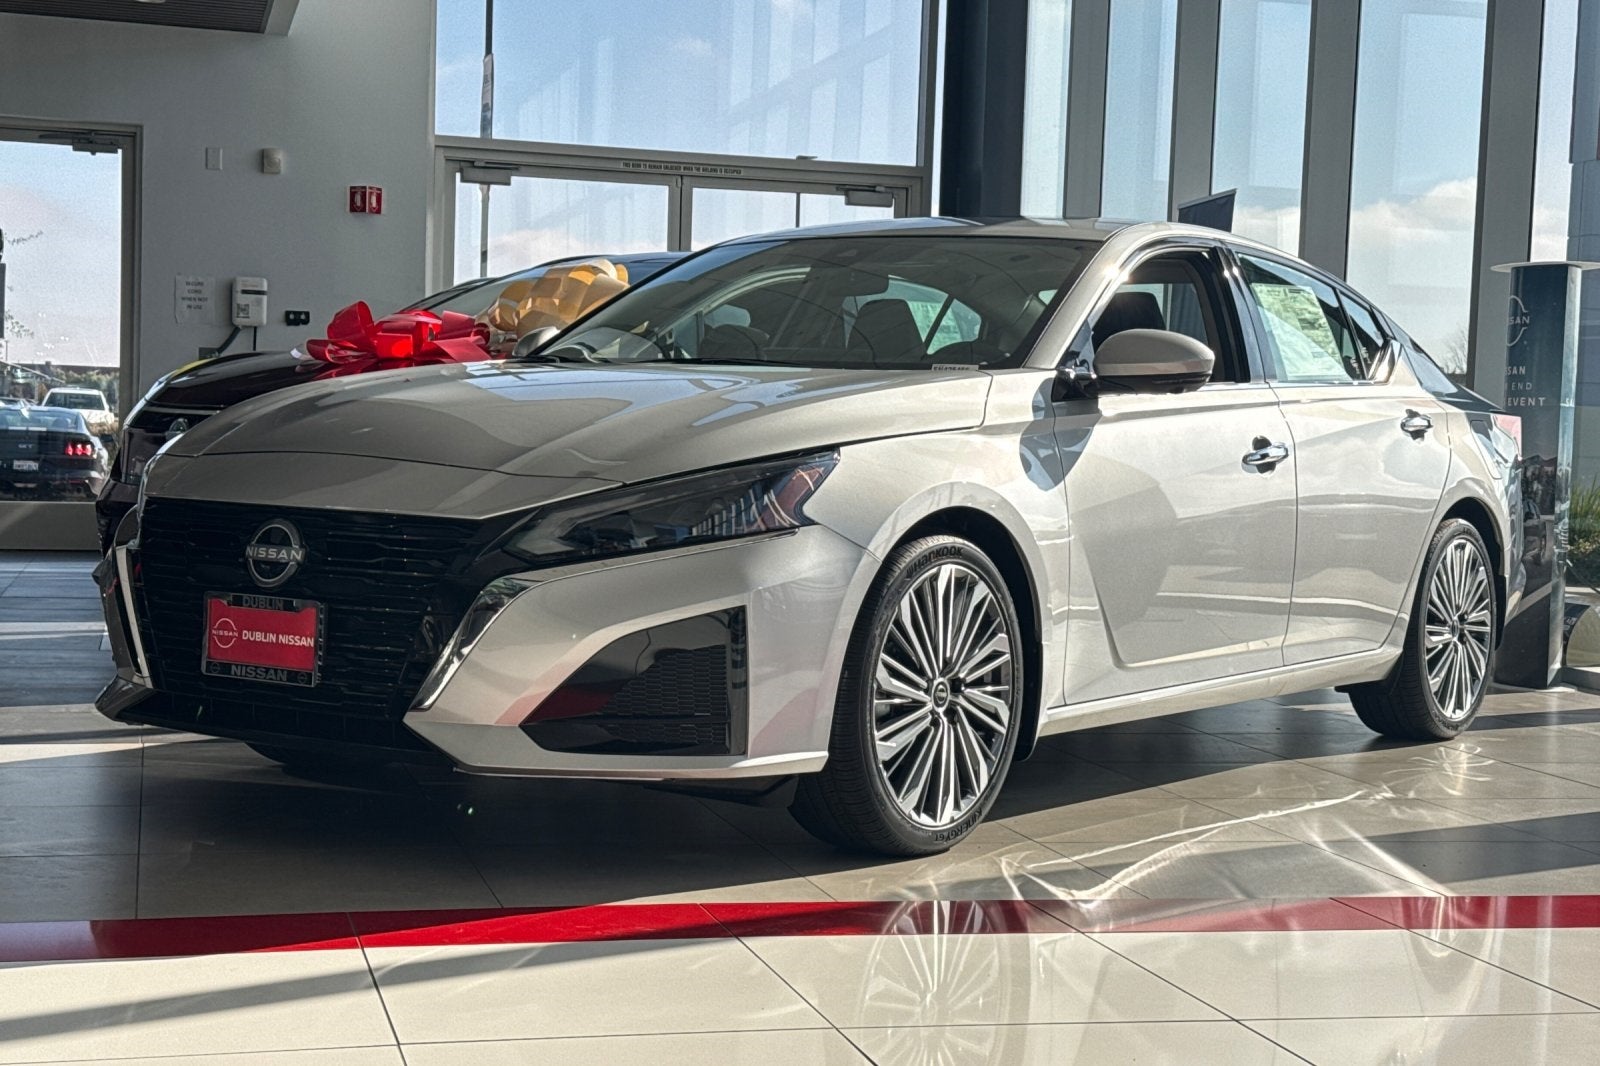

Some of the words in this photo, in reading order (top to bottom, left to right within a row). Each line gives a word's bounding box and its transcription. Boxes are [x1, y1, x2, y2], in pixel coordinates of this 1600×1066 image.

[1507, 397, 1546, 406] EVENT
[245, 545, 303, 561] NISSAN
[242, 595, 284, 610] DUBLIN
[212, 629, 238, 638] NISSAN
[242, 630, 277, 643] DUBLIN
[278, 634, 314, 648] NISSAN
[230, 664, 288, 682] NISSAN
